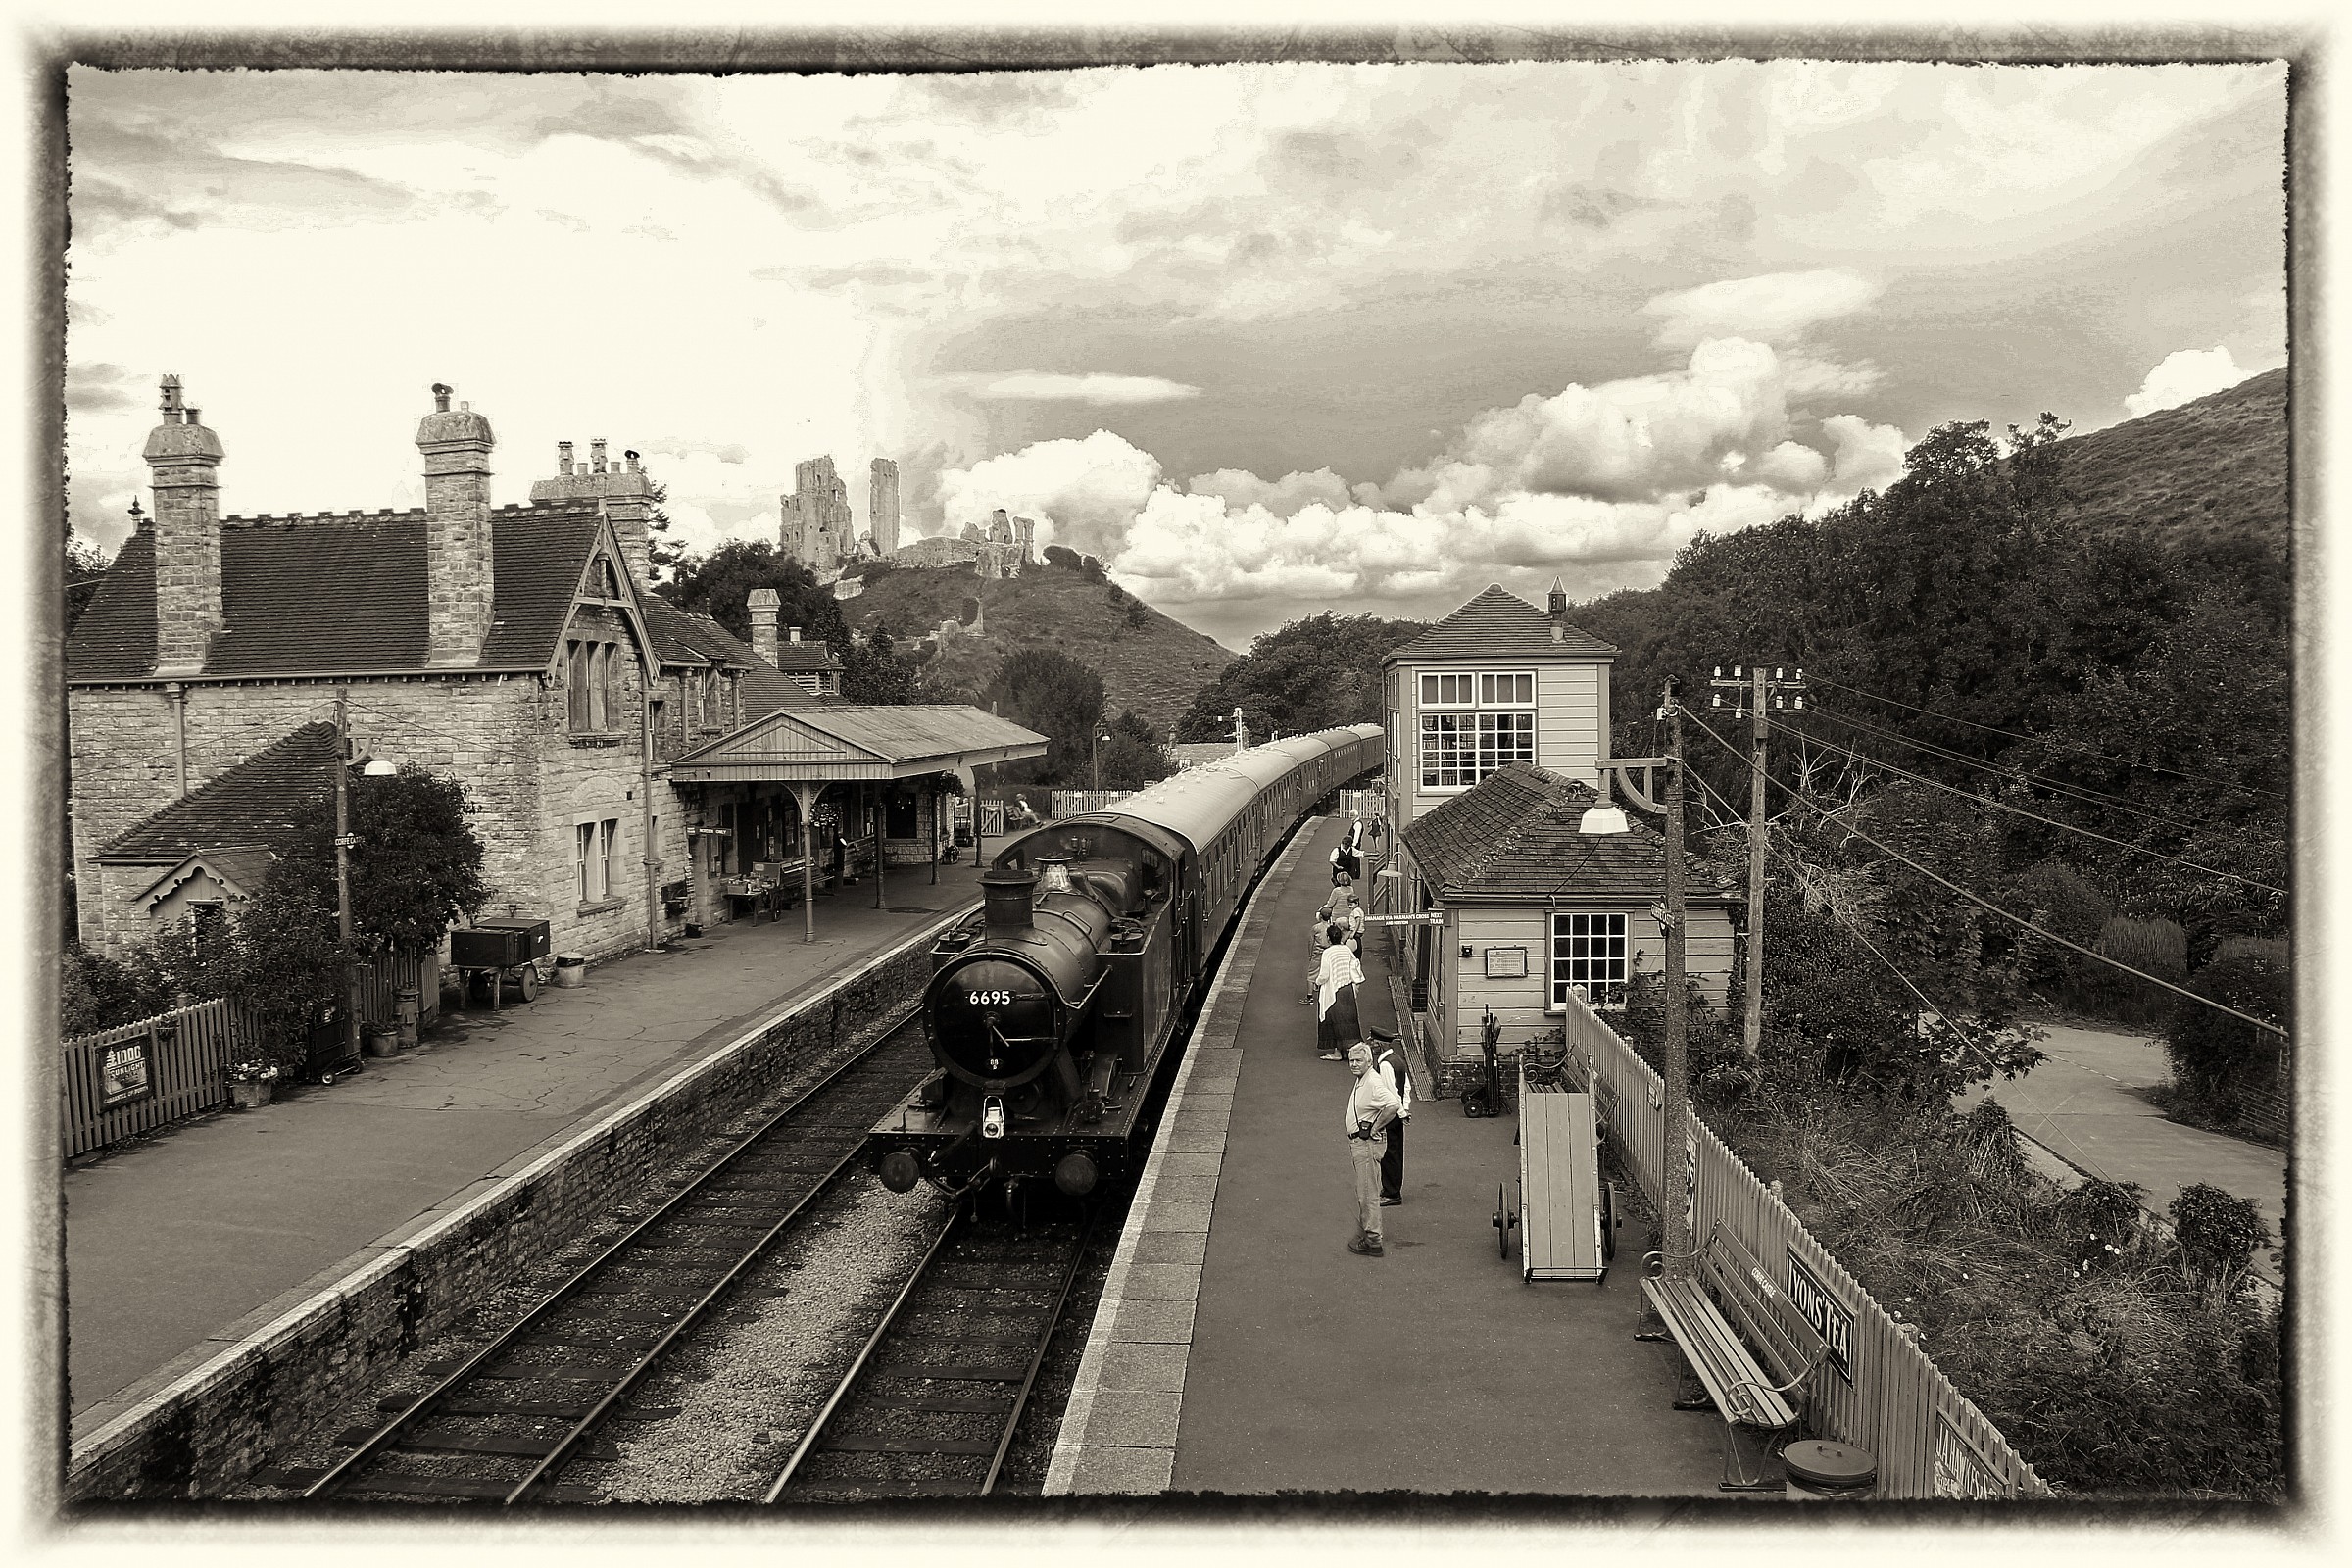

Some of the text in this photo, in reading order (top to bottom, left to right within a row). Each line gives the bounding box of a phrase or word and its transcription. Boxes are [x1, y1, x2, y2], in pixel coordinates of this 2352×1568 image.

[969, 991, 1011, 1004] 6695
[109, 1061, 145, 1081] SUNLIGHT
[1761, 1279, 1777, 1298] CASTLE
[1824, 1297, 1850, 1364] TEA
